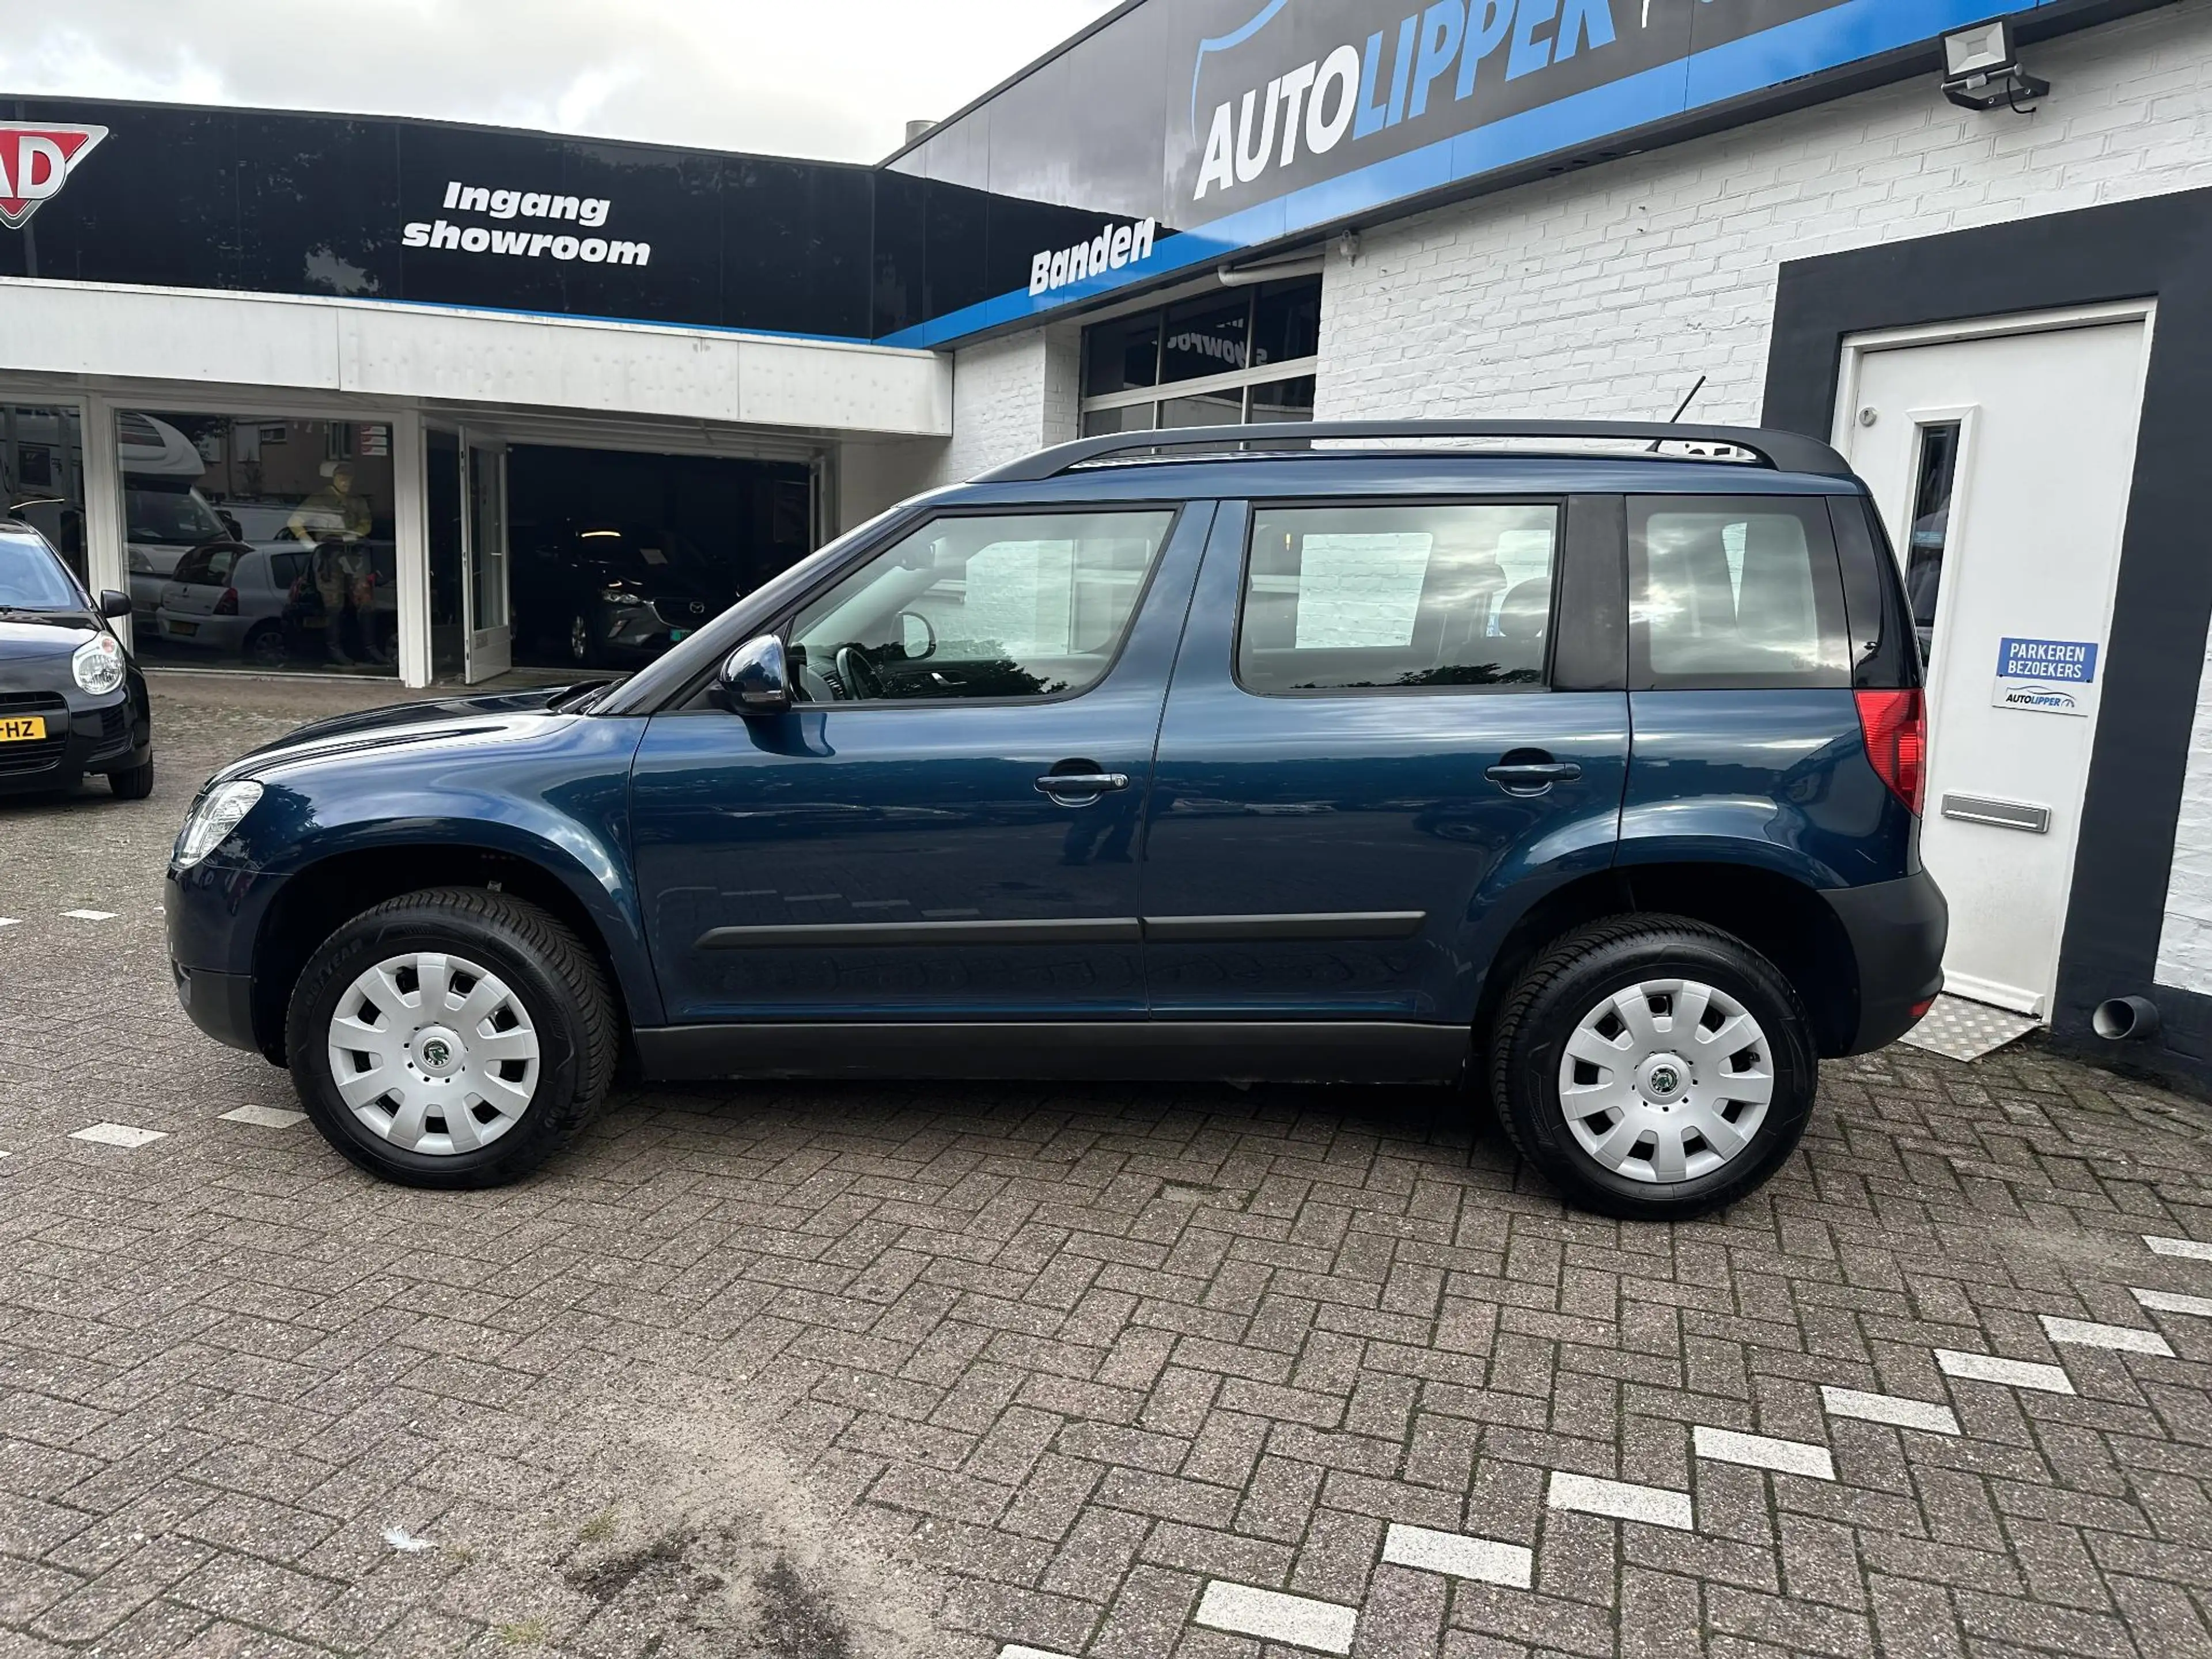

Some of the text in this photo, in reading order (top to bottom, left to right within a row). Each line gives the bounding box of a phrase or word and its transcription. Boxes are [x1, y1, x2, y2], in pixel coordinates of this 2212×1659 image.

[443, 181, 611, 226] Ingang
[402, 220, 651, 266] showroom
[1029, 217, 1155, 297] Banden
[2010, 643, 2085, 661] PARKEREN
[2008, 660, 2082, 678] BEZOEKERS
[2006, 694, 2061, 706] AUTOLIPPER
